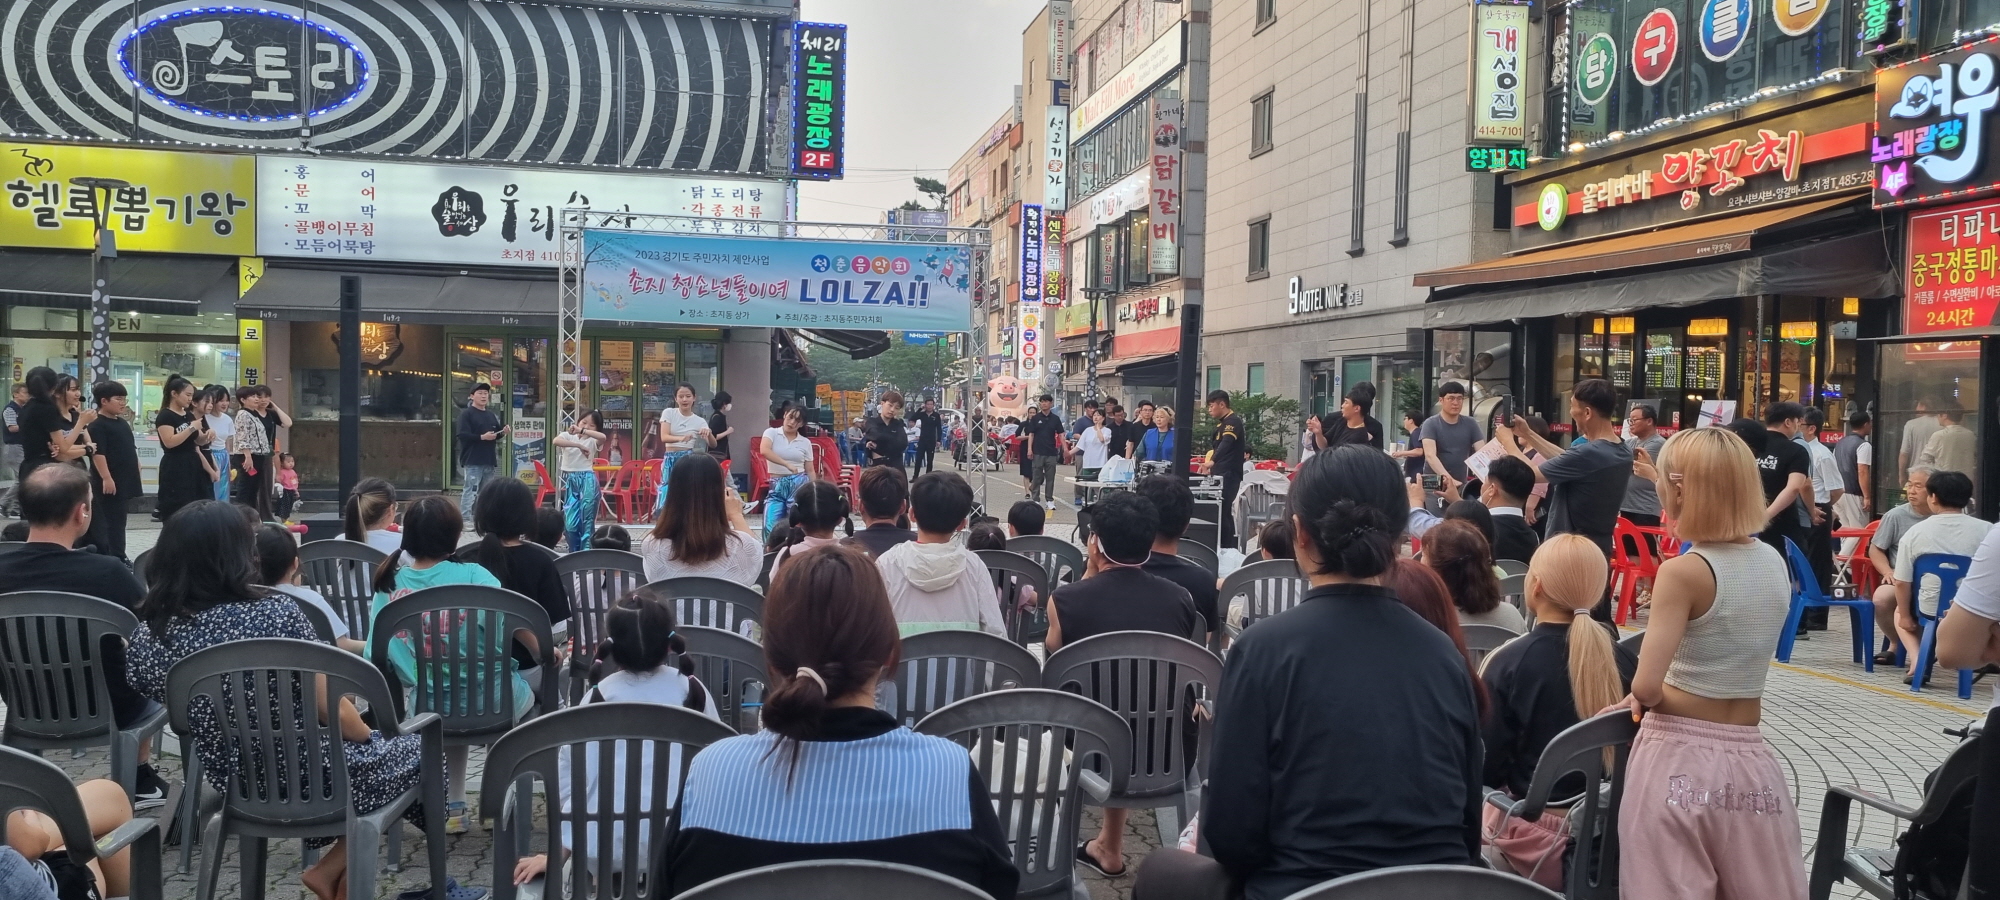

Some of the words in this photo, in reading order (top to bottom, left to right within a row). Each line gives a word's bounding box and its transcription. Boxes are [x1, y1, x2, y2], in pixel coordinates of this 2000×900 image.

[800, 30, 840, 51] 체리
[1865, 24, 1885, 40] 2F
[206, 39, 355, 101] 스토리
[1484, 26, 1519, 120] 개성집
[1114, 72, 1135, 103] More
[806, 55, 833, 148] 노래광장
[1154, 108, 1179, 121] 한가네
[1478, 126, 1522, 136] 414-7101
[1871, 119, 1962, 163] 노래광장
[805, 153, 831, 167] 2F
[1469, 148, 1526, 169] 양꼬치
[1662, 129, 1803, 210] 양꼬치
[1884, 172, 1904, 189] 4F
[1153, 154, 1178, 244] 닭갈비
[294, 220, 374, 236] 골뱅이무침
[294, 239, 376, 255] 모듬어묵탕
[502, 249, 535, 261] 초지점
[635, 250, 660, 261] 2023
[662, 251, 690, 263] 경기도
[693, 253, 730, 265] 주민자치
[732, 254, 770, 266] 제안사업
[813, 256, 909, 274] 청춘음악회
[1912, 245, 2000, 288] 중국정통마
[628, 268, 666, 293] 초지
[672, 273, 789, 304] 청소년들이여
[799, 279, 930, 308] LOLZA!!
[1289, 276, 1299, 314] 9
[1300, 287, 1323, 313] HOTEL
[1325, 283, 1345, 309] NINE
[1914, 290, 1934, 304] 커플룸
[1942, 286, 1978, 302] 수면실완비
[688, 310, 703, 318] 장소
[710, 311, 733, 319] 초지동
[734, 311, 750, 320] 상가
[784, 314, 818, 323] 주최/주관
[824, 314, 883, 324] 초지동주민자치회
[1926, 307, 1975, 326] 24시간
[514, 421, 531, 430] 생맥주
